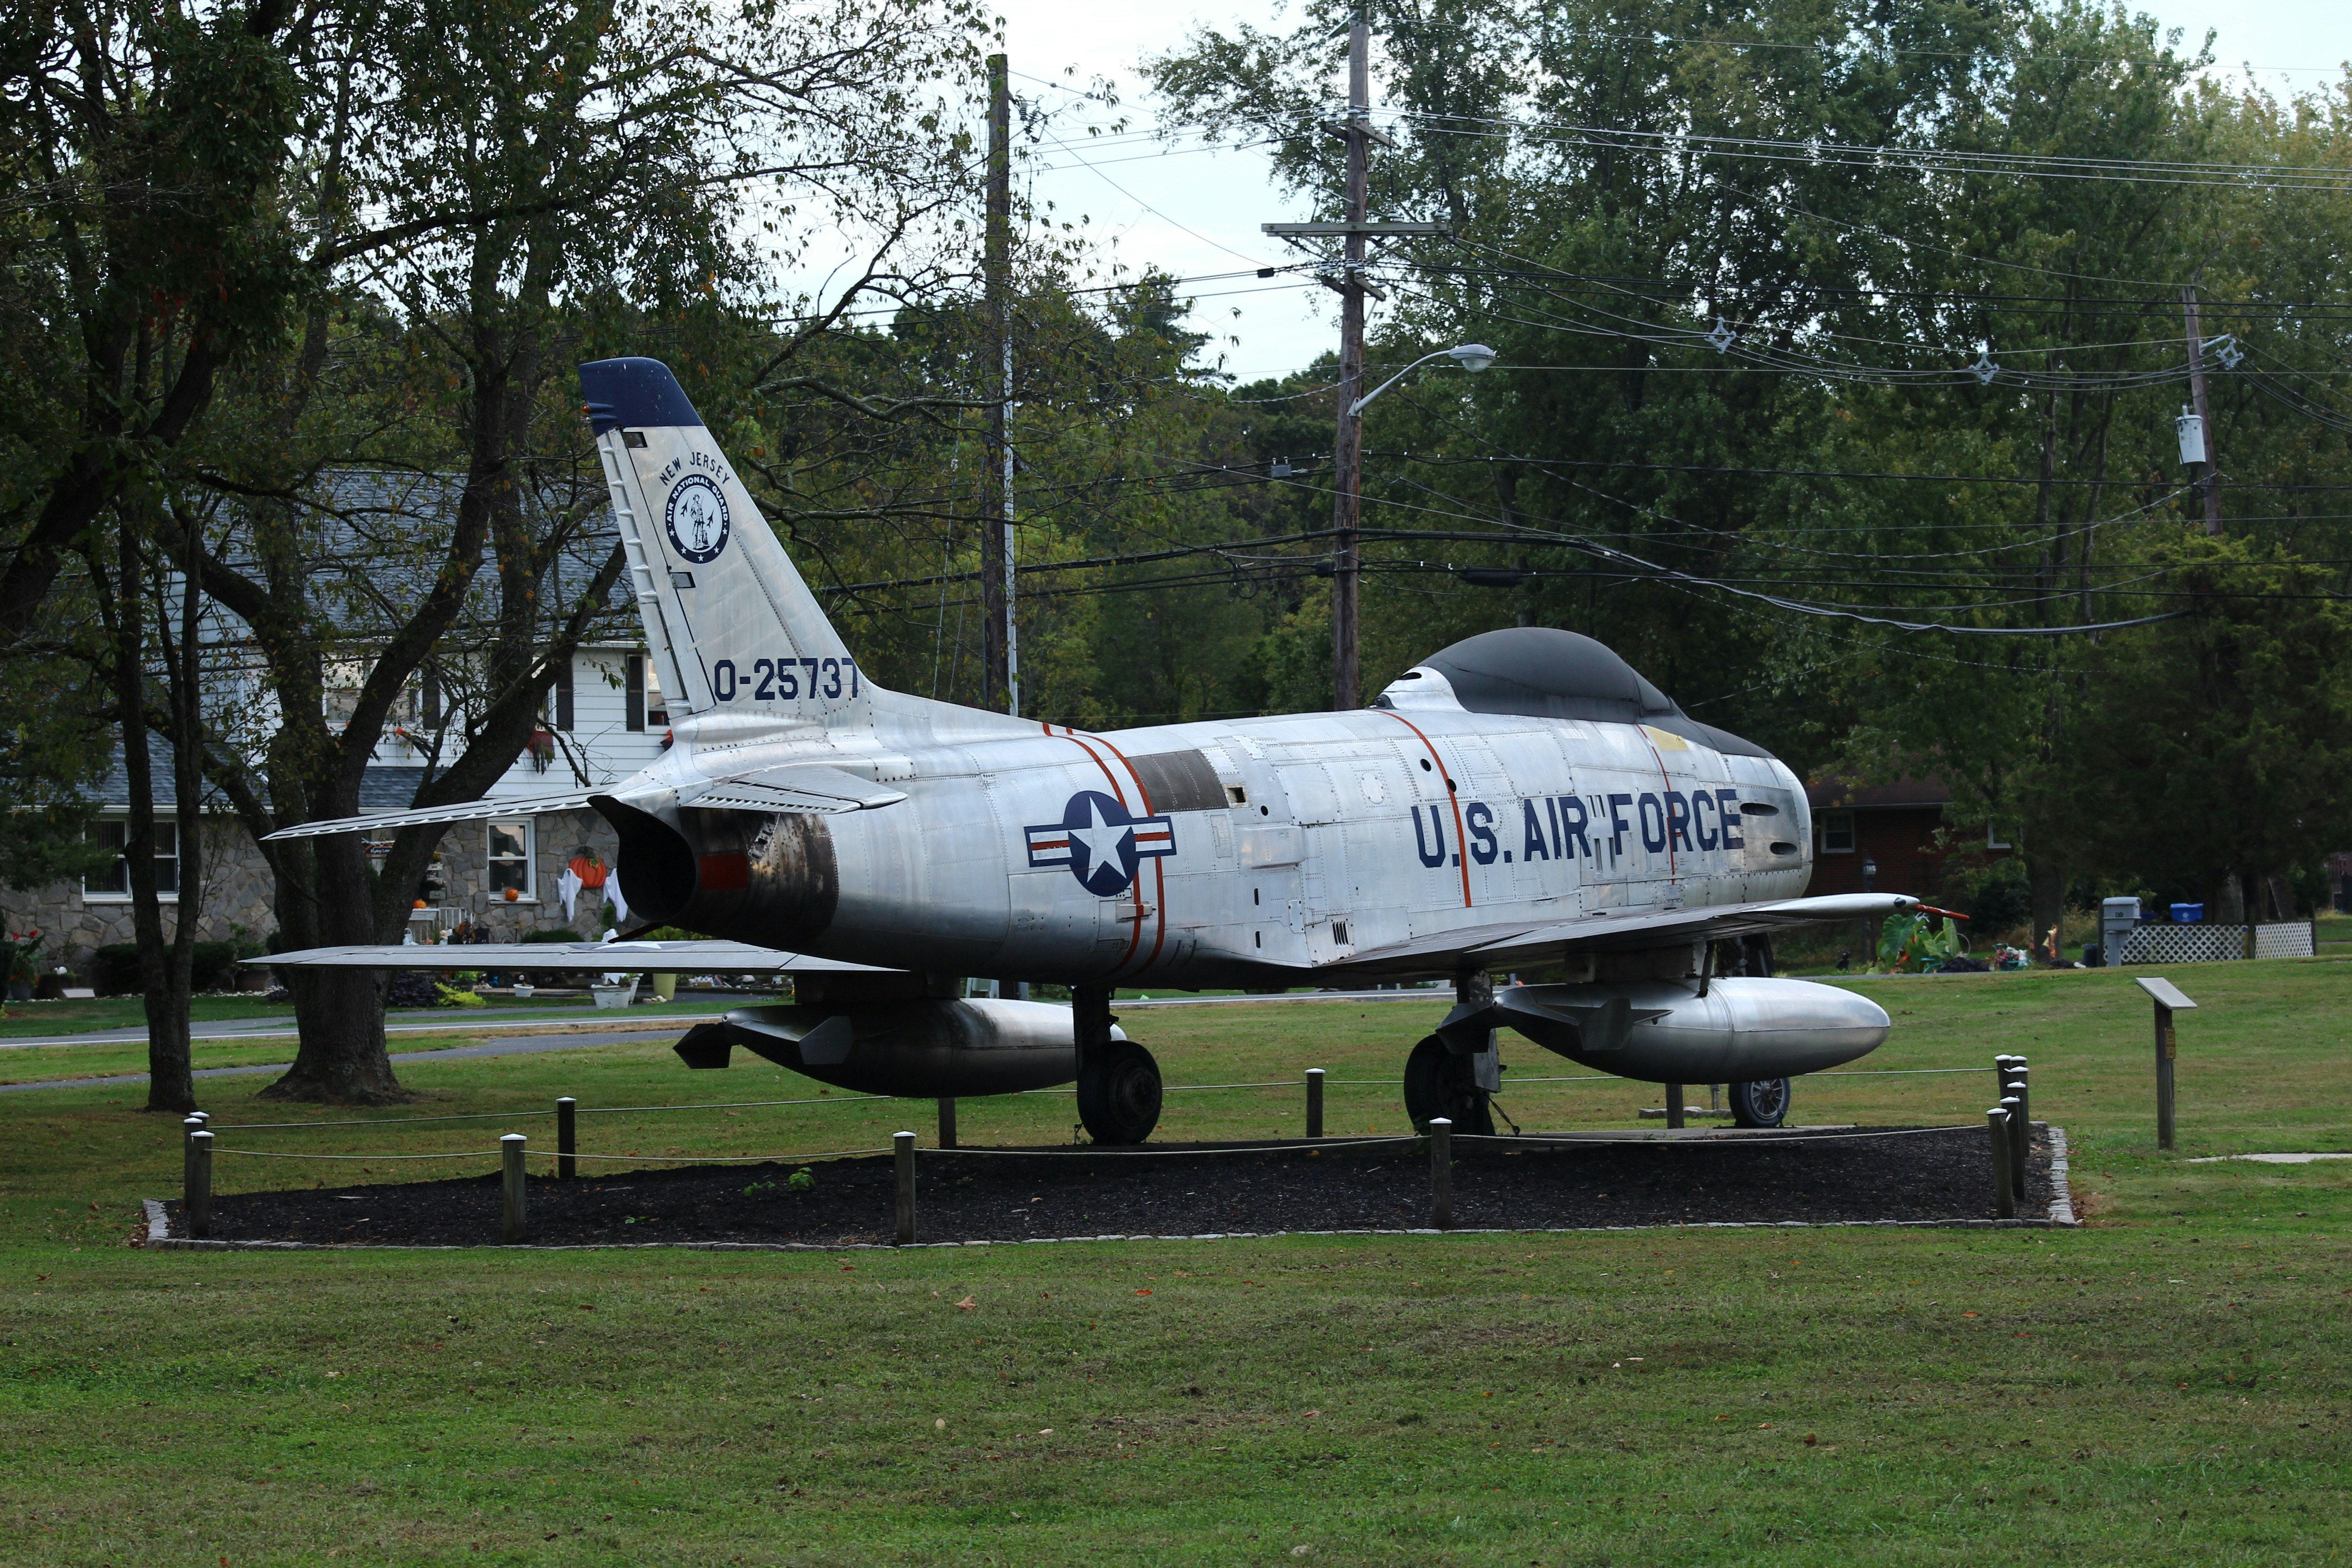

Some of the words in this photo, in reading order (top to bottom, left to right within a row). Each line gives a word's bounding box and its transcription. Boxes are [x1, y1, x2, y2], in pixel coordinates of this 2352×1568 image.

[659, 457, 681, 486] NEW
[690, 452, 730, 484] JERSEY
[672, 476, 710, 500] NATIONAL
[712, 486, 728, 521] GUARD
[1411, 802, 1512, 868] U.S.
[1524, 796, 1592, 862] AIR
[1607, 789, 1744, 855] FORCE
